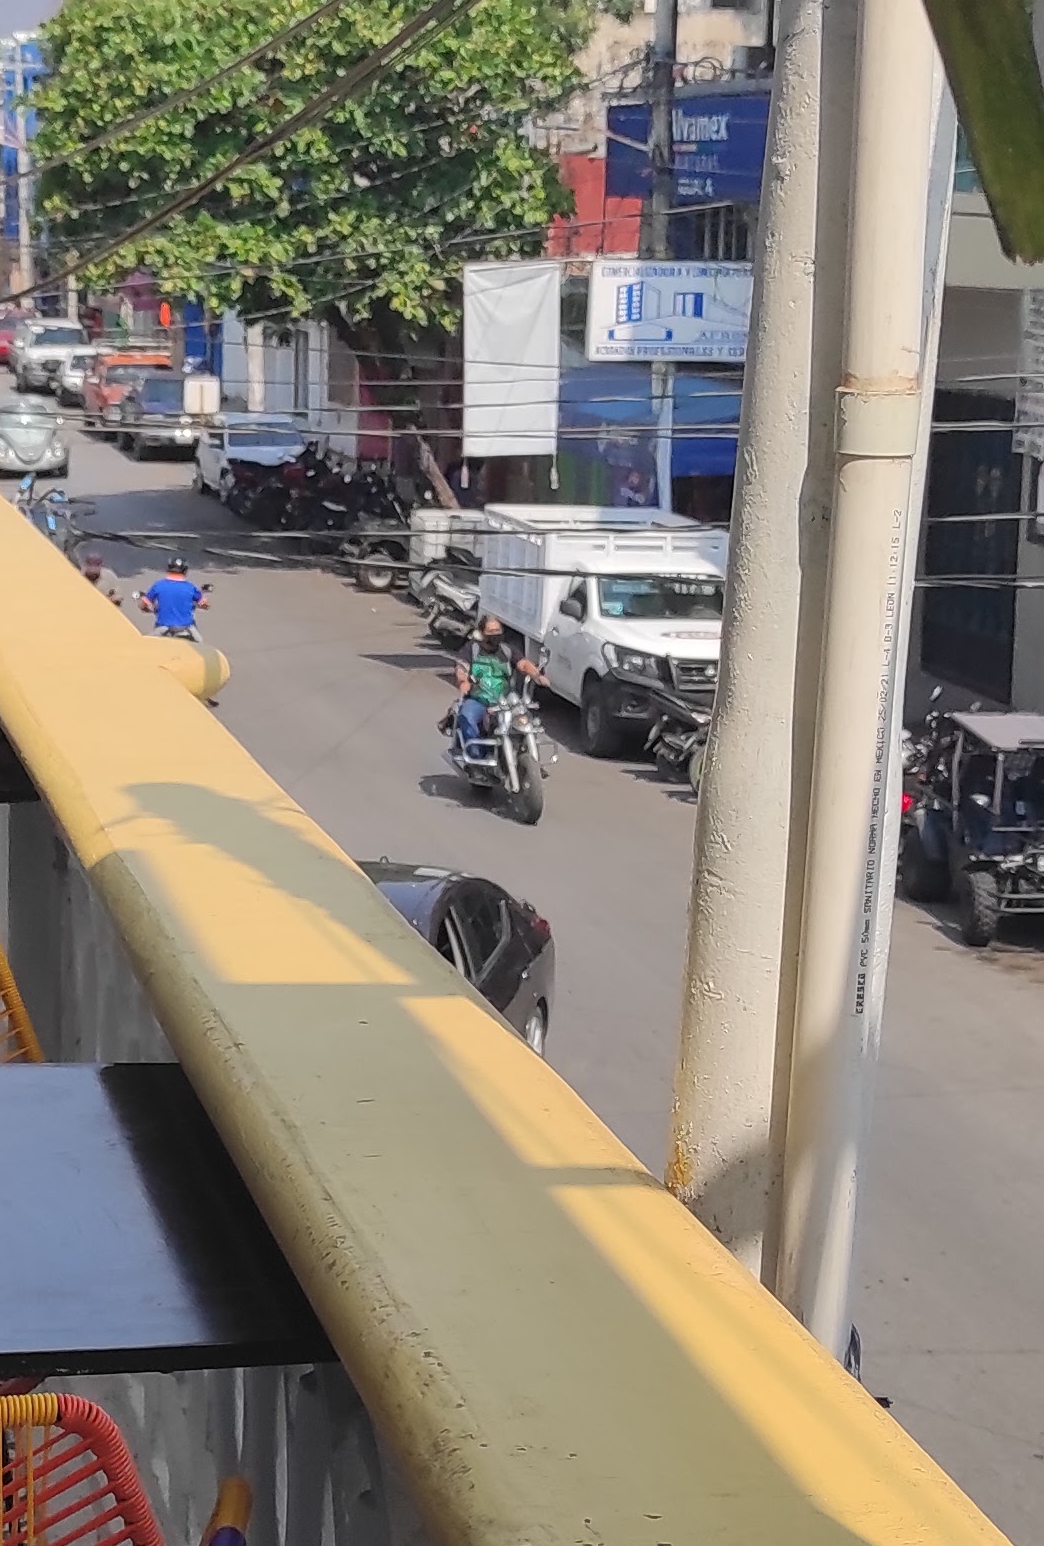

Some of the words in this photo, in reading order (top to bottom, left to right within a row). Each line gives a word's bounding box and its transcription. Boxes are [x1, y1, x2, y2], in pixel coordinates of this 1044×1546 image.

[891, 508, 902, 529] L-2
[875, 727, 886, 764] MEXICO
[873, 769, 882, 783] EN
[870, 787, 881, 819] HECHO
[863, 859, 875, 914] SANITARIO
[859, 948, 869, 968] PVC
